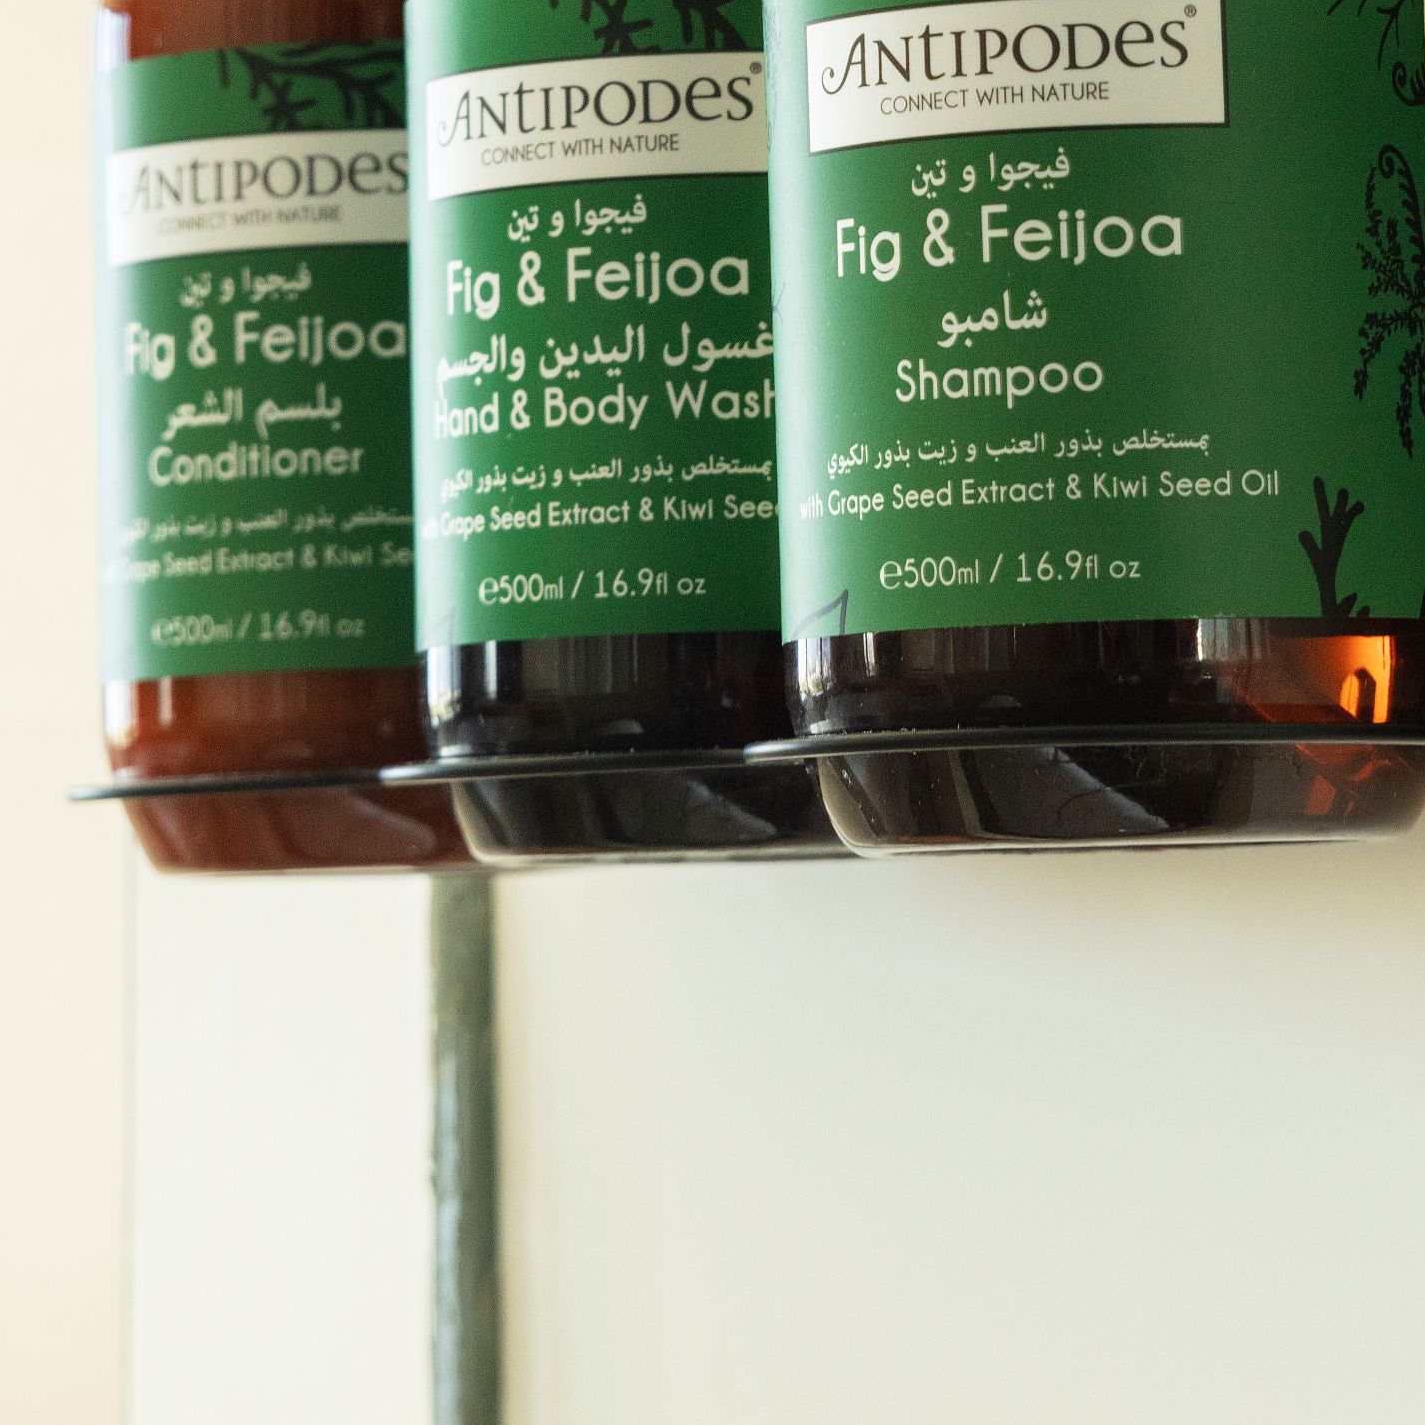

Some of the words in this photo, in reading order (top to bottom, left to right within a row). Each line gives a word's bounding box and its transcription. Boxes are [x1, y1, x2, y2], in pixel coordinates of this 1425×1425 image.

[879, 89, 969, 116] CONNECT
[976, 86, 1024, 105] WITH
[1031, 81, 1110, 104] NATURE
[480, 142, 556, 167] CONNECT
[562, 137, 604, 156] WITH
[610, 133, 680, 154] NATURE
[989, 146, 1071, 192] فيجوا
[911, 158, 947, 198] تين
[958, 163, 976, 193] و
[232, 208, 273, 227] WITH
[279, 204, 341, 223] NATURE
[548, 210, 565, 237] و
[836, 217, 901, 282] Fig
[922, 207, 955, 267] &
[980, 203, 1183, 265] Feijoa
[446, 259, 501, 320] Fig
[517, 250, 546, 306] &
[567, 246, 749, 304] Feijoa
[936, 288, 1048, 348] شامبو
[124, 321, 175, 381] Fig
[187, 313, 217, 367] &
[234, 310, 407, 366] Feijoa
[895, 357, 1103, 410] Shampoo
[433, 392, 500, 439] Hand
[510, 388, 531, 430] &
[544, 382, 649, 430] Body
[148, 440, 365, 487] Conditioner
[490, 502, 542, 532] Seed
[548, 499, 630, 527] Extract
[638, 496, 654, 521] &
[664, 496, 713, 521] Kiwi
[724, 493, 779, 520] See
[799, 495, 824, 521] with
[827, 489, 885, 521] Grape
[891, 479, 952, 511] Seed
[961, 476, 1055, 505] Extract
[1066, 474, 1082, 500] &
[1093, 473, 1148, 499] Kiwi
[1159, 469, 1232, 497] Seed
[1241, 469, 1279, 496] Oil
[380, 541, 413, 568] Se
[989, 553, 1003, 584] /
[1016, 549, 1099, 584] 16.9fl
[1109, 559, 1142, 579] oz
[571, 571, 585, 599] /
[594, 567, 668, 599] 16.9fl
[677, 577, 707, 595] oz
